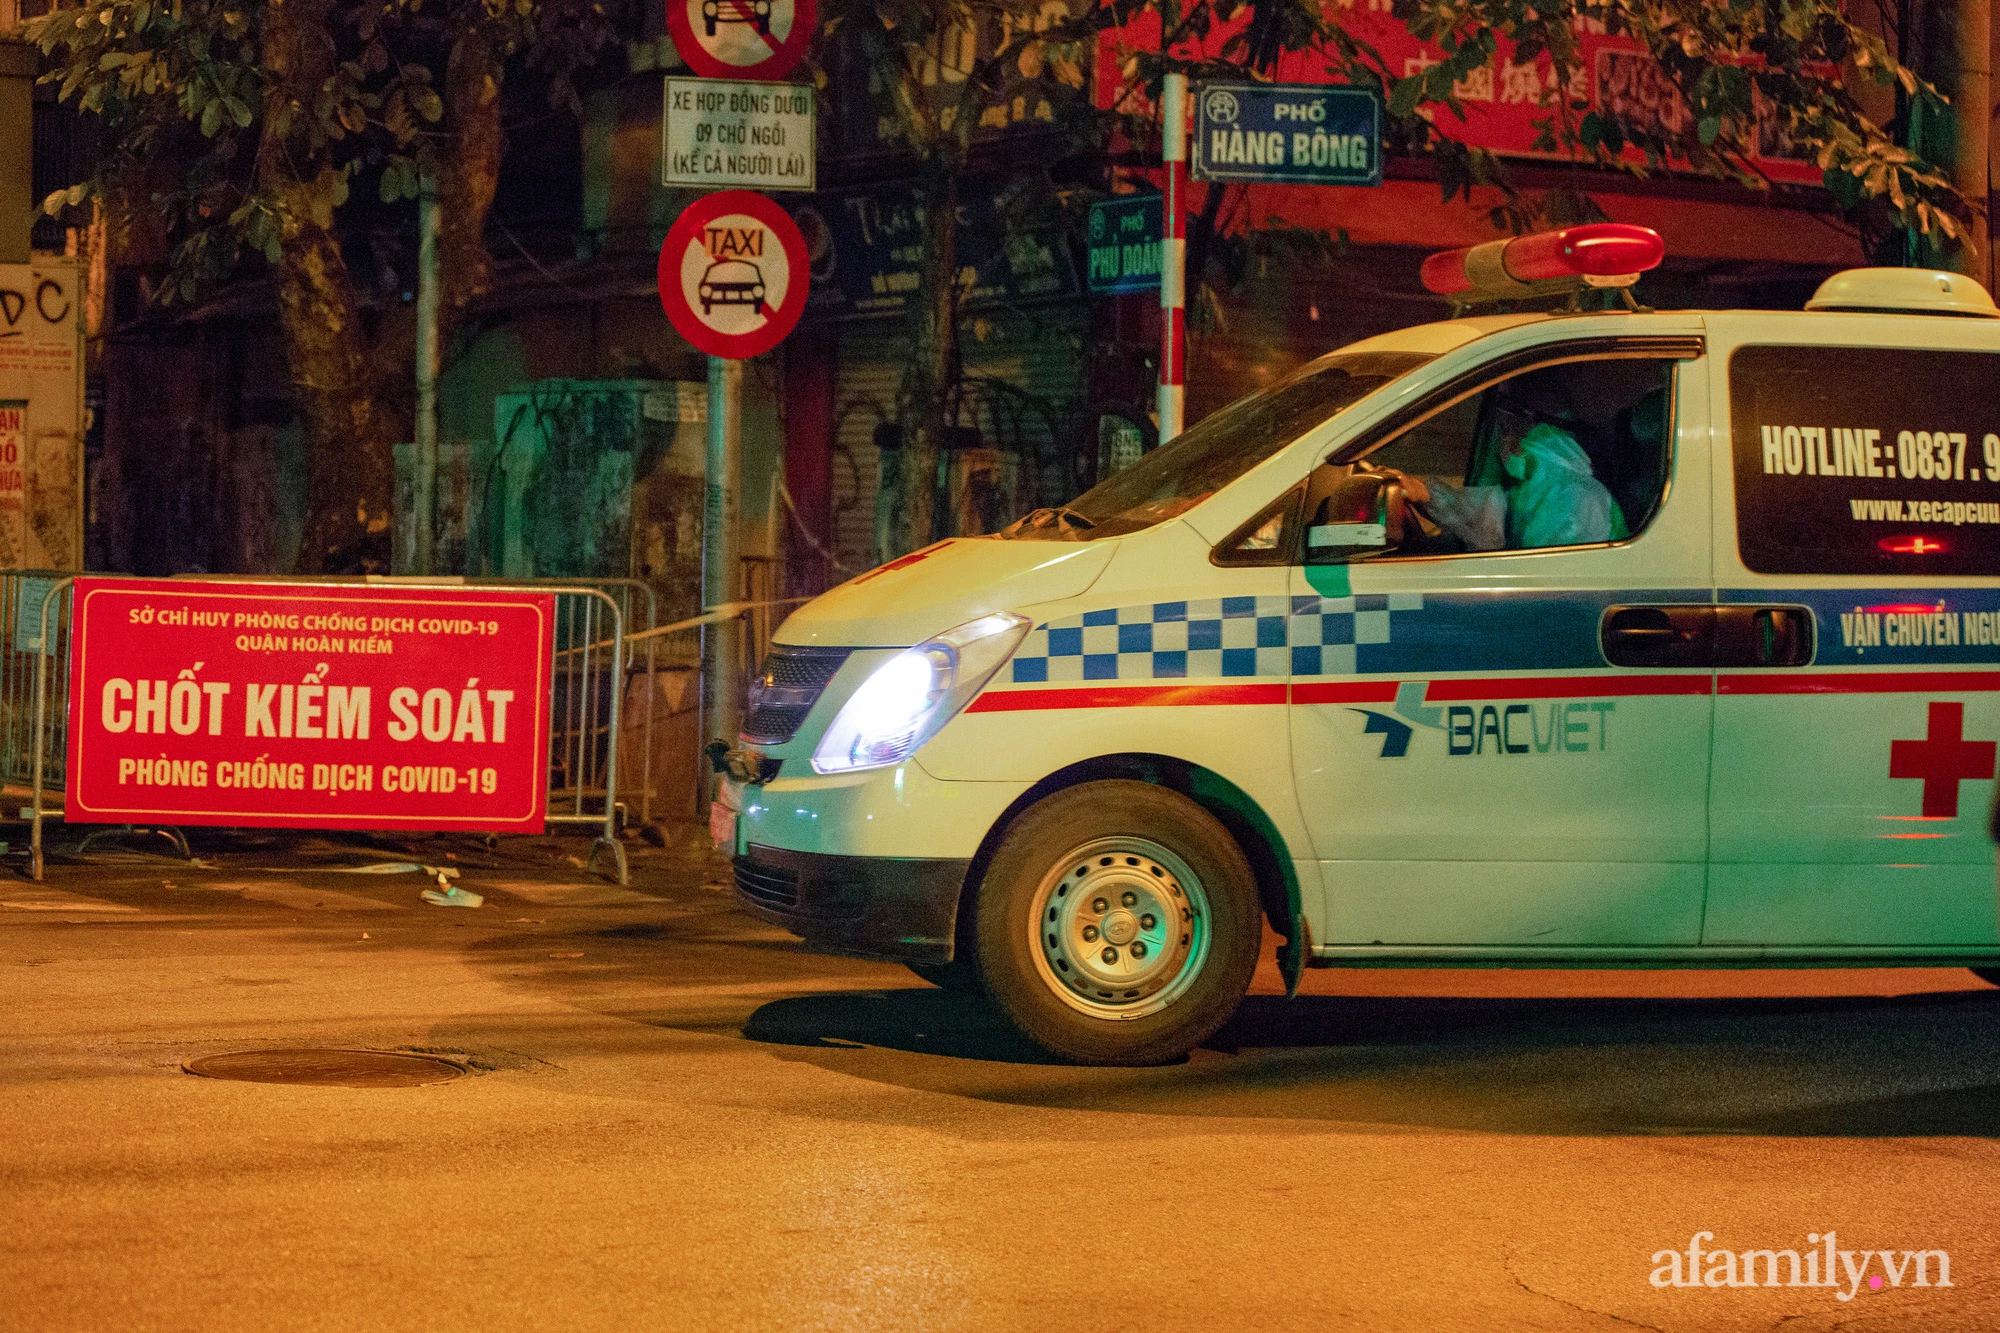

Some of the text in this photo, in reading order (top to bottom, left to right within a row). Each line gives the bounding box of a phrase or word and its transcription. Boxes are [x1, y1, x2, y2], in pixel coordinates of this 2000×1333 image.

[673, 90, 692, 111] XE
[696, 92, 726, 114] HỢP
[1273, 98, 1327, 122] PHỐ
[696, 123, 713, 143] 09
[1211, 122, 1368, 169] HÀNG BÔNG
[727, 152, 773, 176] NGƯỜI
[777, 152, 805, 177] LÁI)
[705, 227, 764, 256] TAXI
[128, 604, 499, 637] SỞ CHỈ HUY PHÒNG CHỐNG DỊCH COVID-19
[1840, 605, 1881, 655] VẬN
[1885, 598, 1960, 647] CHUYỂN
[235, 633, 394, 655] QUẬN HOÀN KIẾM
[101, 661, 515, 744] CHỐT KIỂM SOÁT
[118, 752, 498, 797] PHÒNG CHỐNG DỊCH COVID-19
